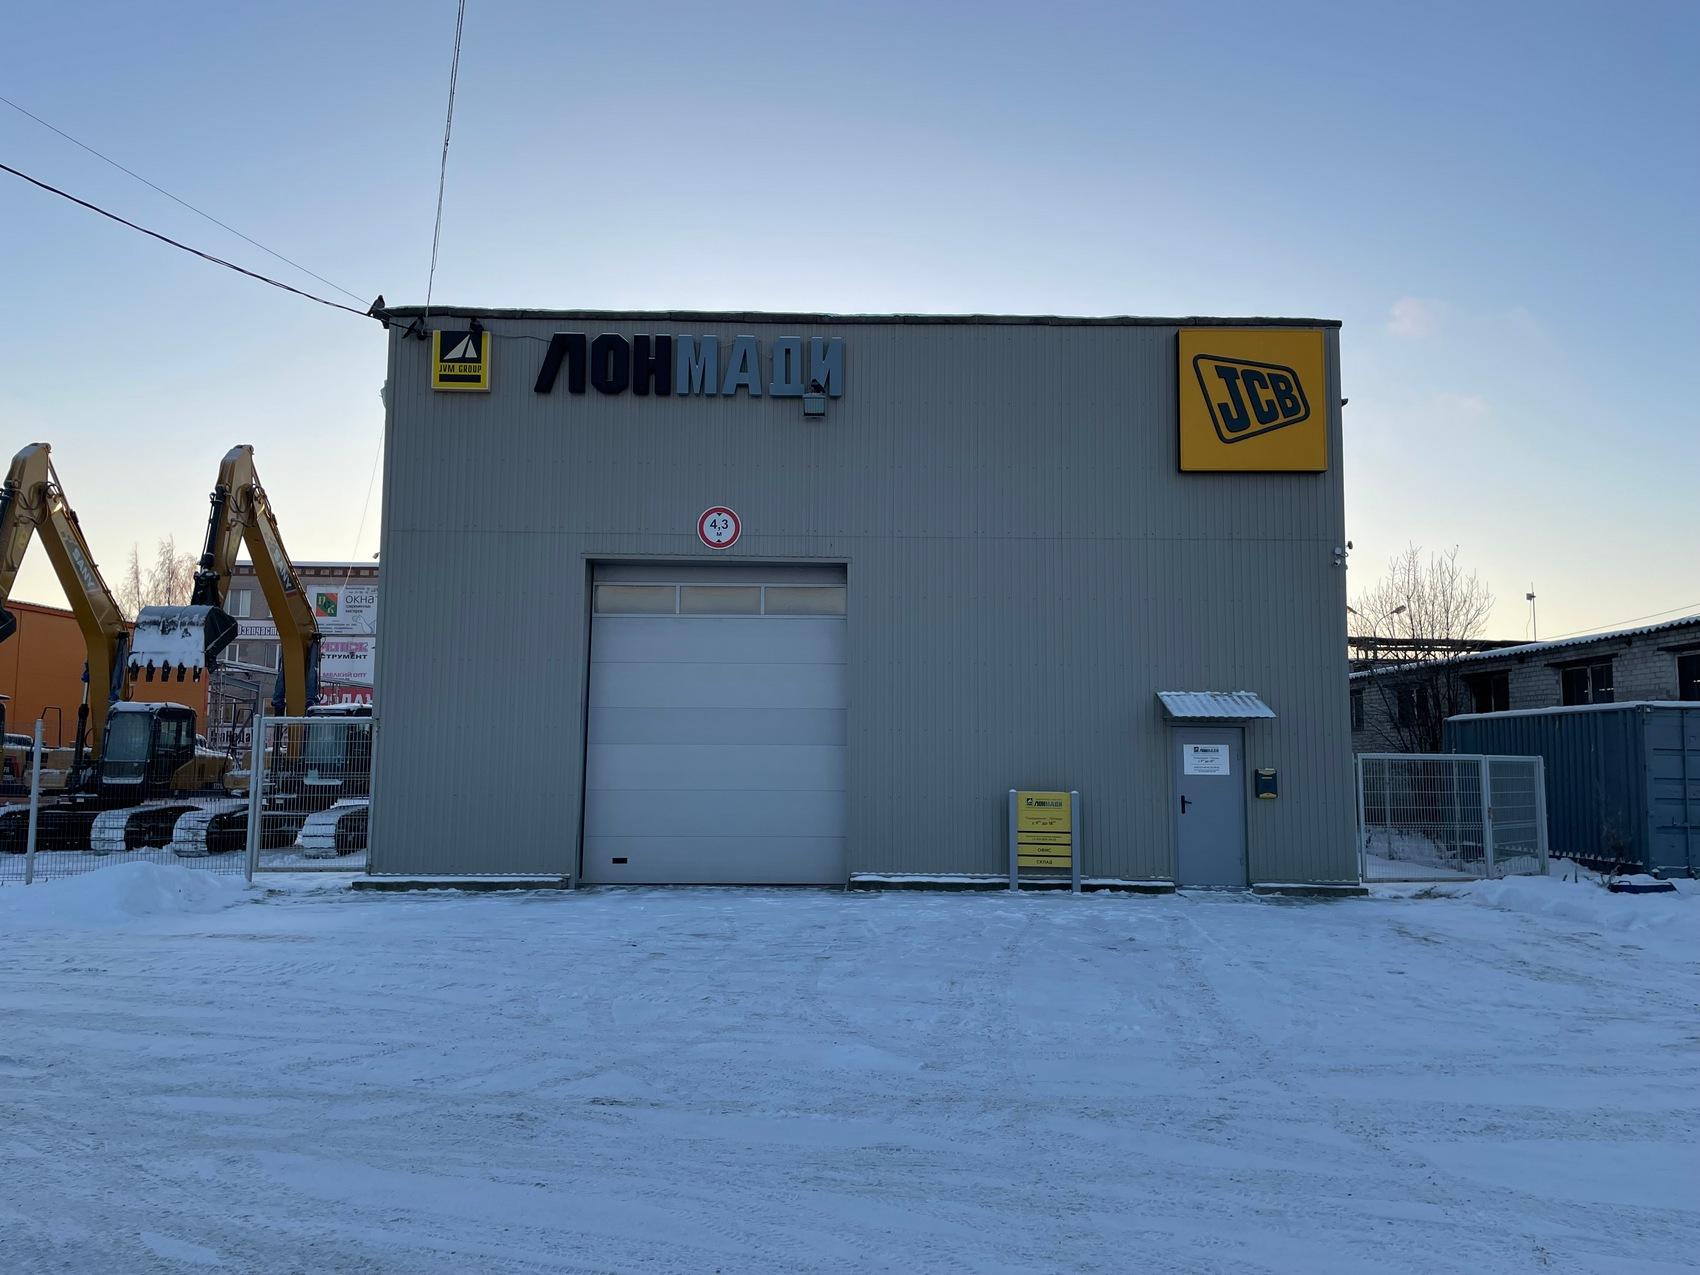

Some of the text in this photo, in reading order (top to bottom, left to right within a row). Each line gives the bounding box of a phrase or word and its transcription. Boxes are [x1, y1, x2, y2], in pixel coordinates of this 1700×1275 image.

[439, 364, 482, 373] JVM GROUP
[534, 332, 846, 397] ЛОНМАДИ
[1214, 365, 1302, 433] JCB
[710, 519, 729, 531] 4,3
[71, 546, 95, 588] SANY
